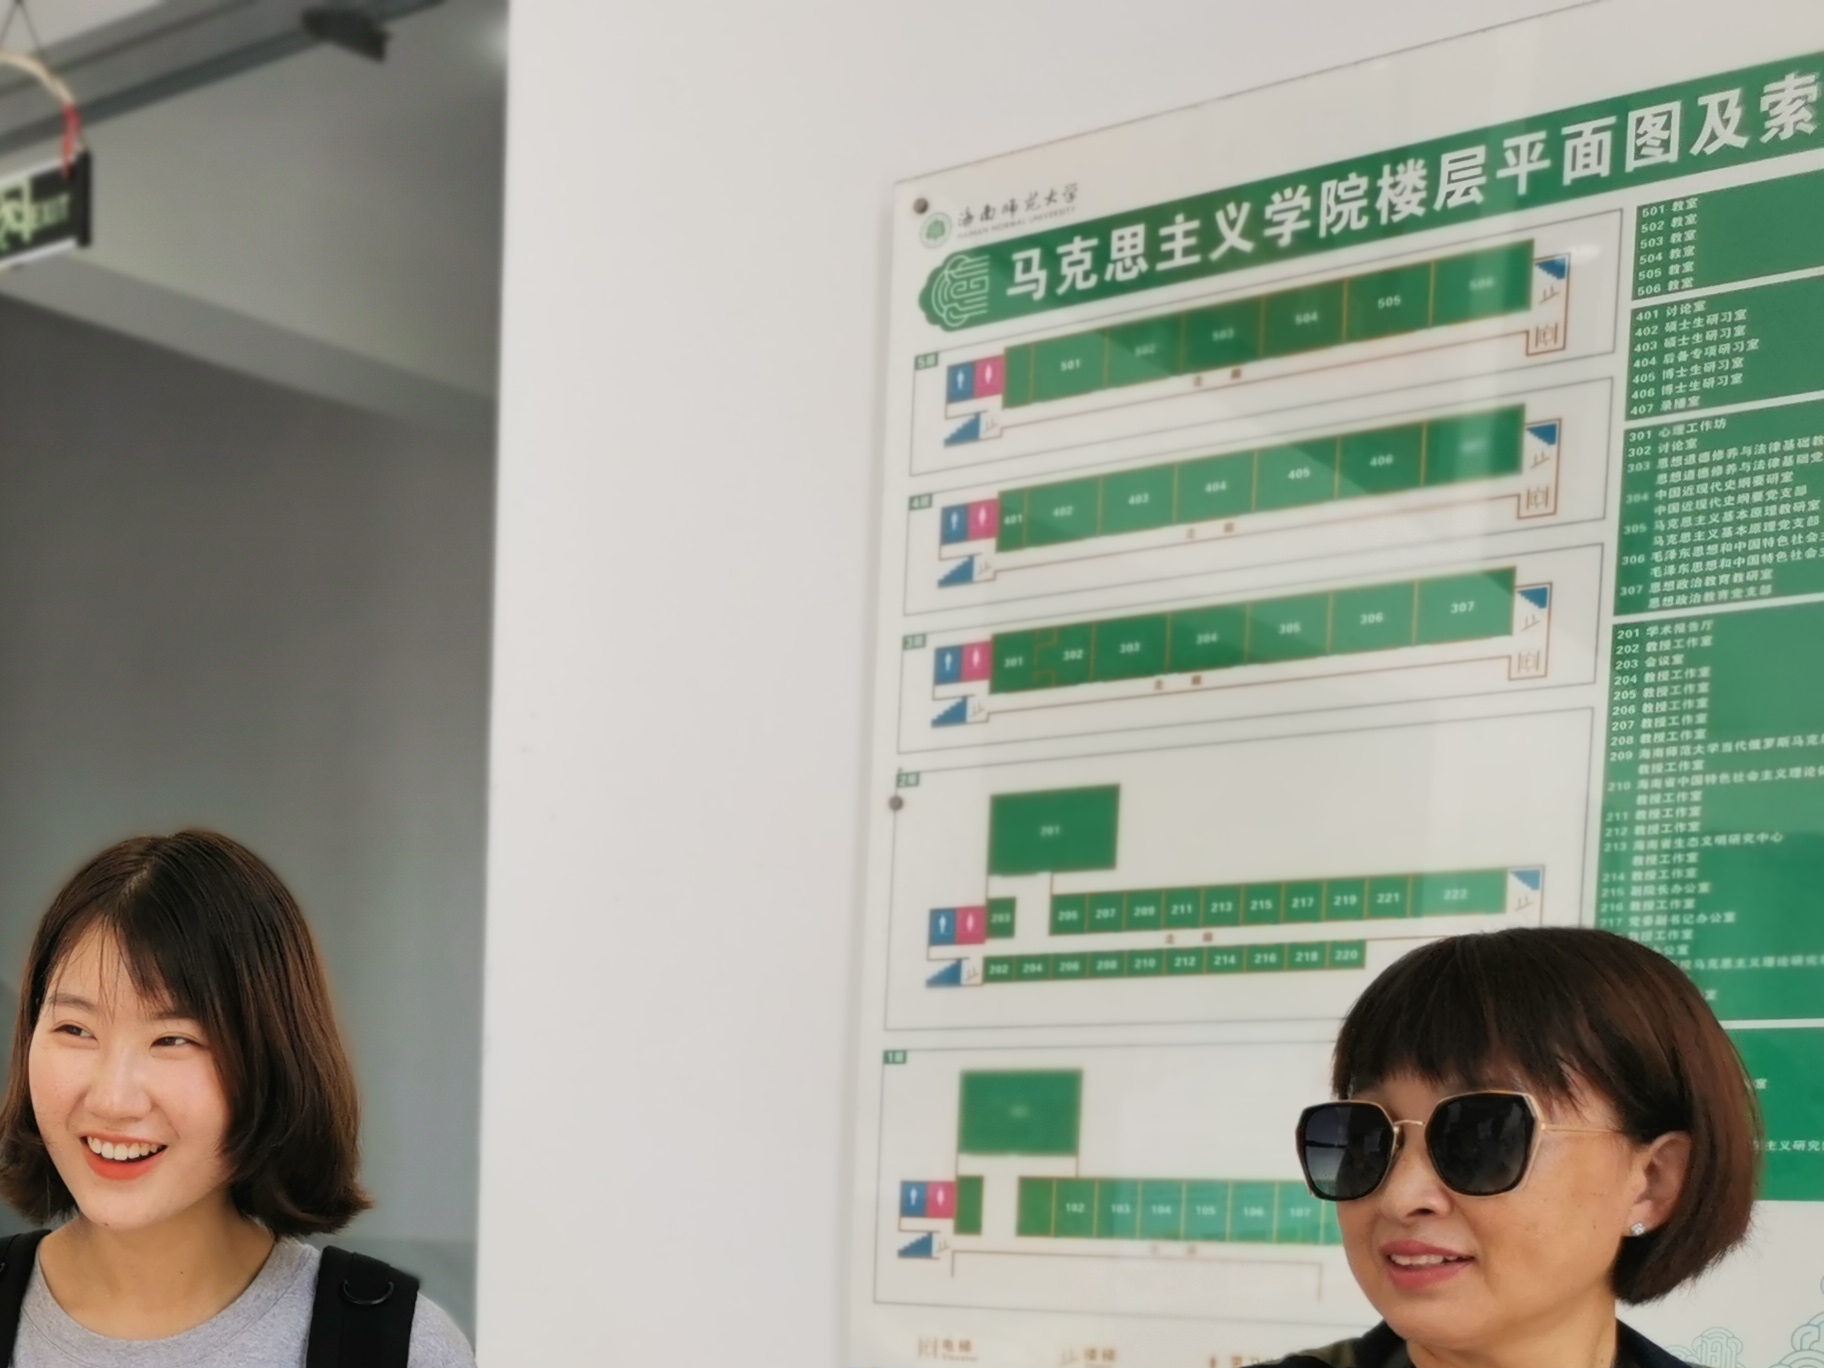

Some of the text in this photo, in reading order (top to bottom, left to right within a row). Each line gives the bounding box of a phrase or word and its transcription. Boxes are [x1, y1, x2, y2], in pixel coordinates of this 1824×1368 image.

[1642, 198, 1698, 217] 501 教室
[1641, 214, 1697, 232] 502 教室
[1640, 229, 1697, 248] 503 教室
[1639, 245, 1696, 264] 504 教室
[1639, 261, 1695, 280] 505 教室
[1638, 277, 1695, 295] 506 教室
[1636, 300, 1706, 321] 401 讨论室
[1635, 309, 1747, 337] 402 硕士生研习室
[1634, 325, 1746, 352] 403 硕士生研习室
[1633, 355, 1657, 368] 404
[1632, 357, 1744, 384] 405 博士生研习室
[1631, 373, 1743, 399] 406 博士生研习室
[1630, 403, 1654, 415] 407
[1629, 430, 1652, 441] 301
[1628, 438, 1697, 457] 302 讨论室
[1617, 628, 1640, 639] 201
[1616, 643, 1640, 654] 202
[1616, 654, 1684, 670] 203 会议室
[1615, 674, 1638, 685] 204
[1614, 690, 1637, 701] 205
[1612, 704, 1635, 715] 206
[1611, 720, 1634, 731] 207
[1611, 735, 1633, 746] 208
[1610, 750, 1633, 761] 209
